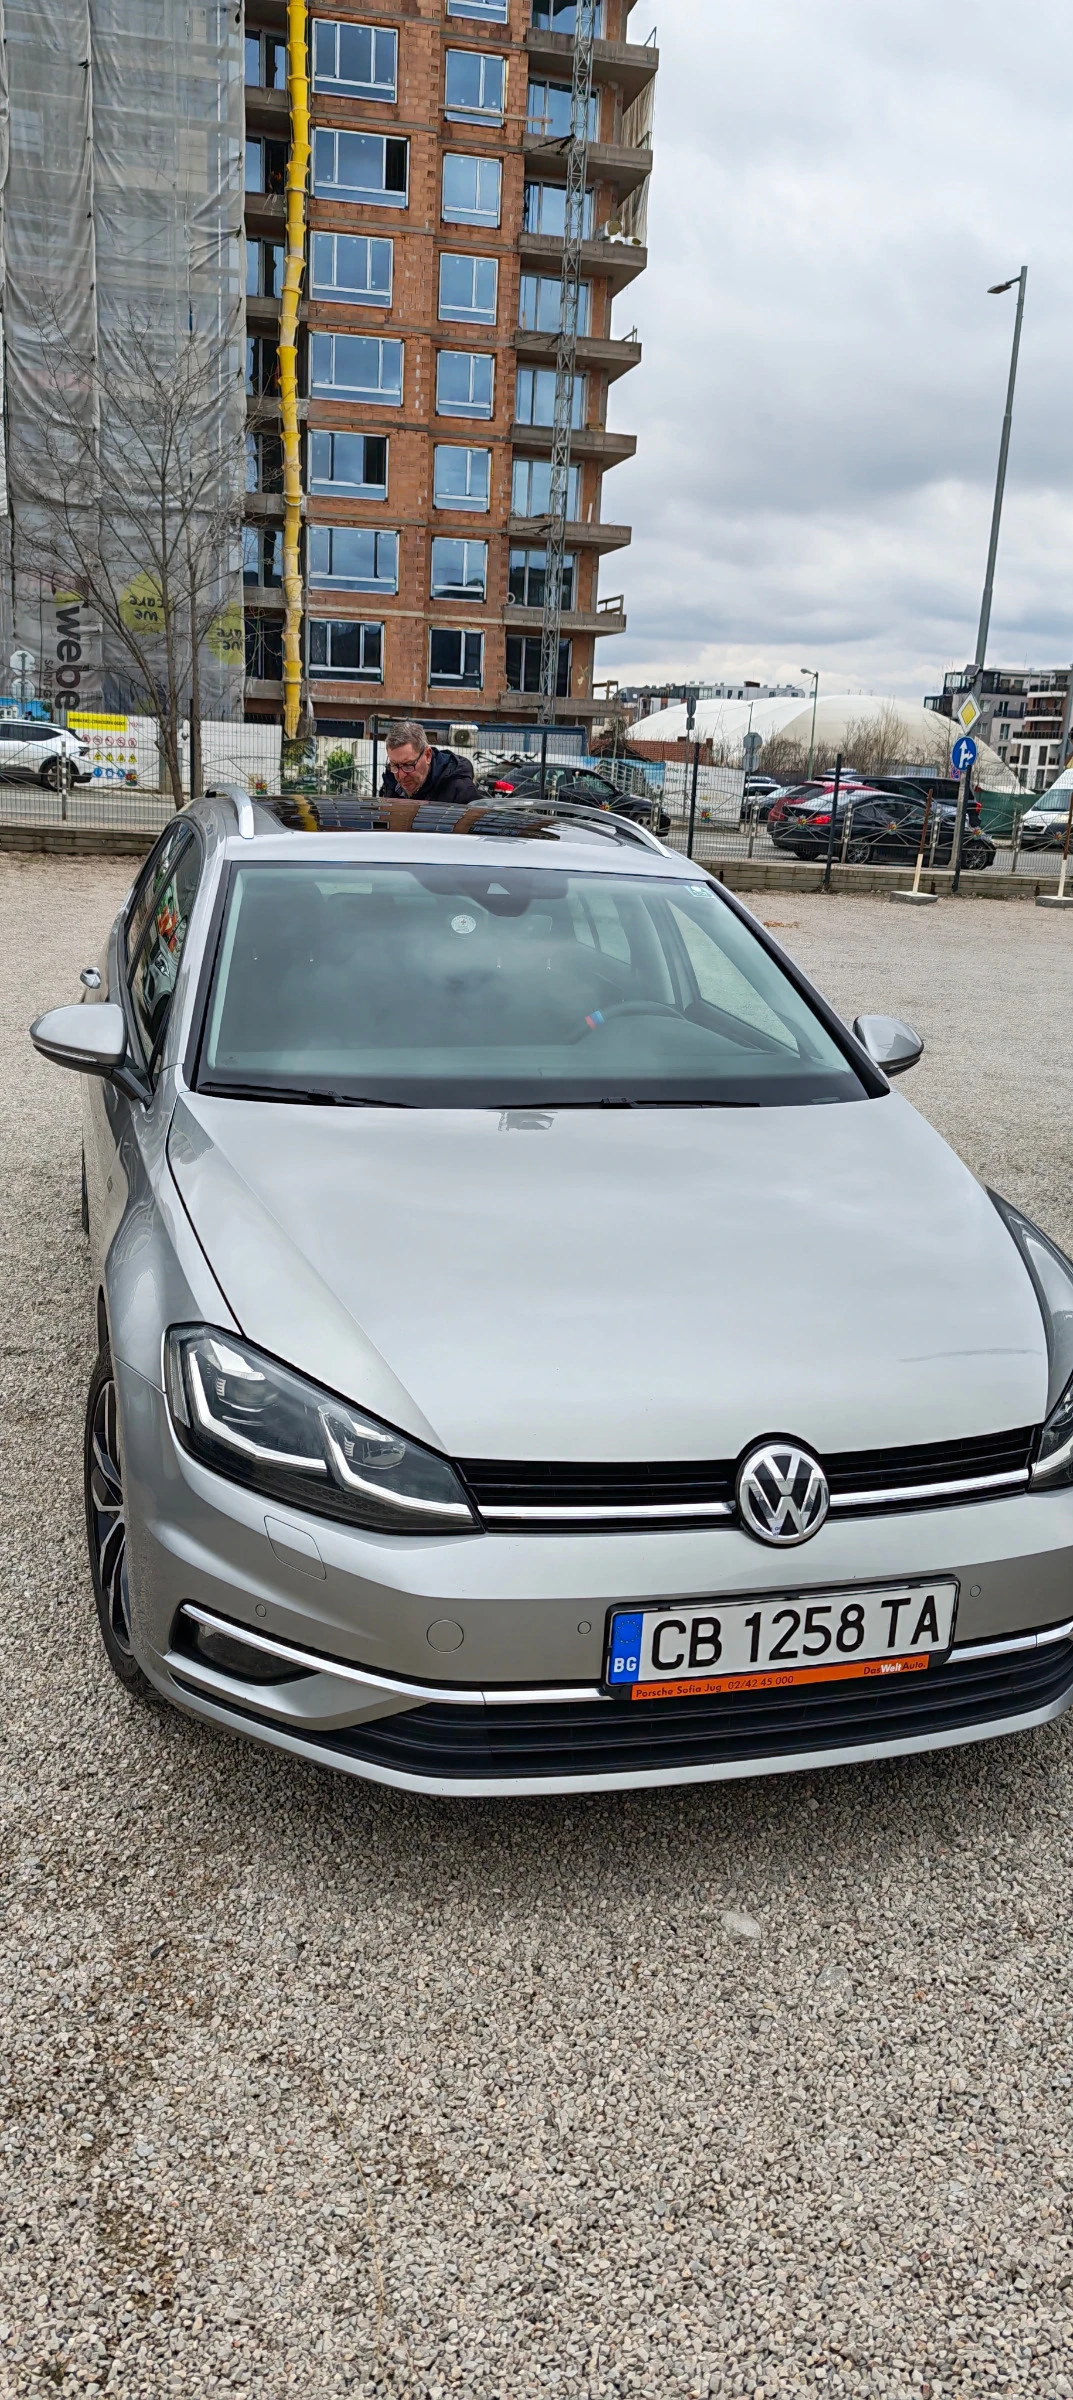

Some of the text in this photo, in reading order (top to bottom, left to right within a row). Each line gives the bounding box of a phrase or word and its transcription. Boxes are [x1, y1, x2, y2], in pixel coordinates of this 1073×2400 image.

[215, 627, 242, 639] are
[54, 605, 90, 711] webe
[651, 1594, 940, 1671] CB 1258 TA
[613, 1656, 638, 1673] BG
[635, 1675, 794, 1698] Porsche Sofia Jug 02/42 45 000
